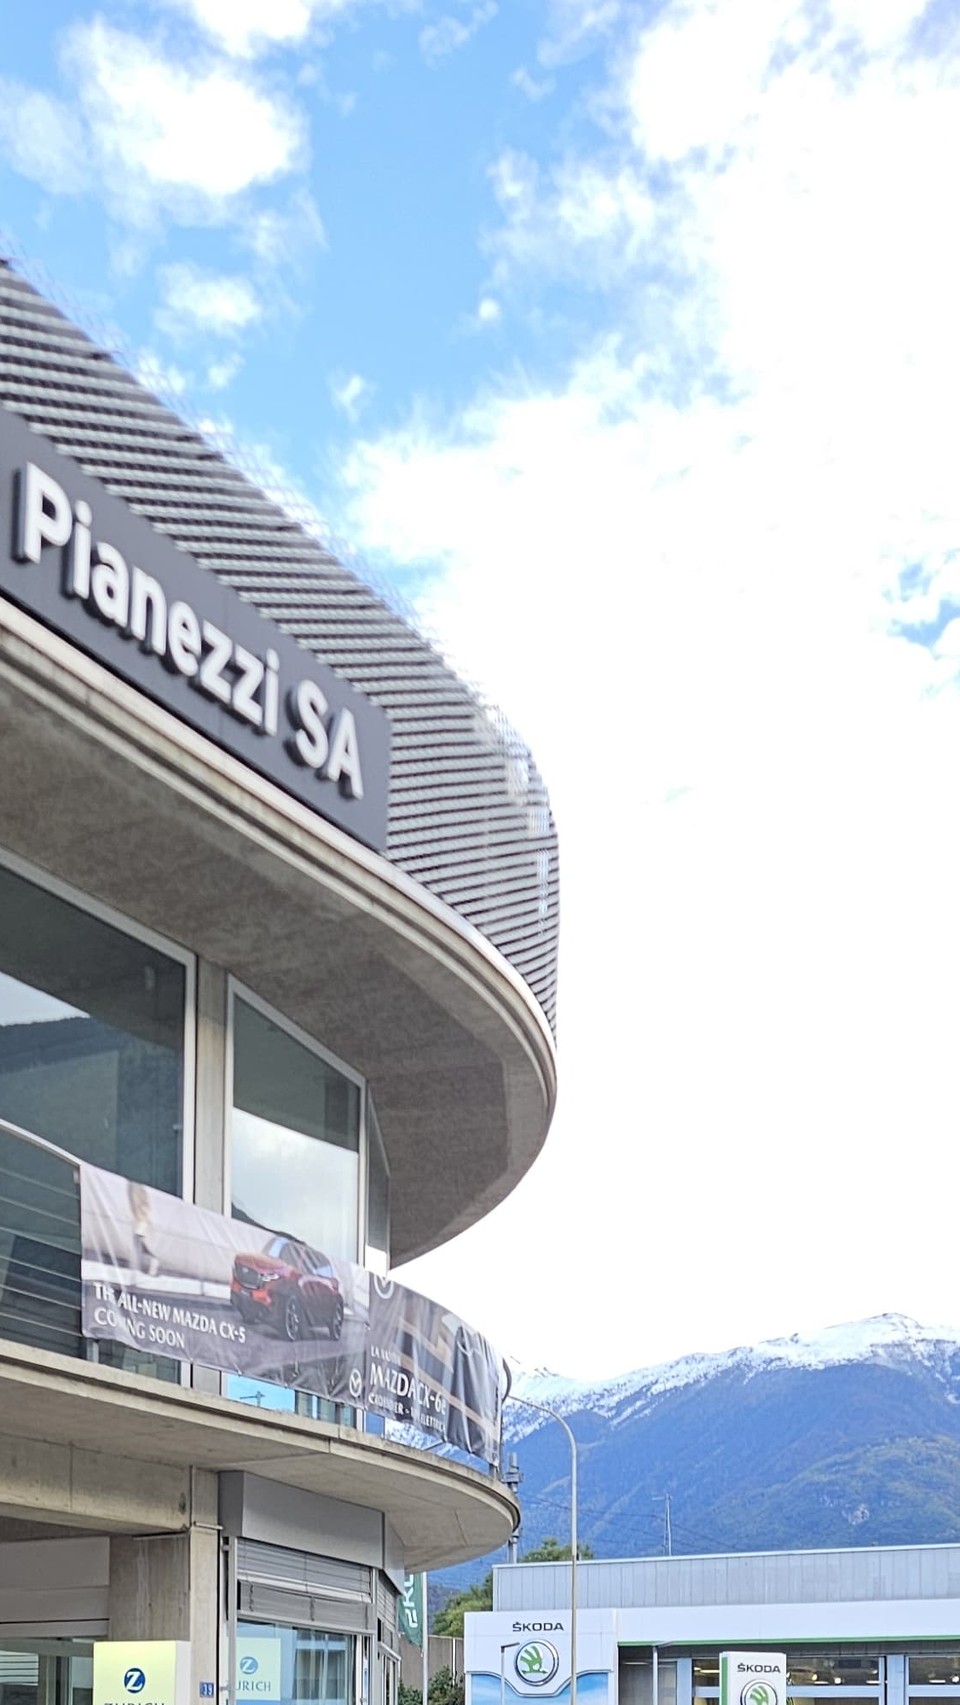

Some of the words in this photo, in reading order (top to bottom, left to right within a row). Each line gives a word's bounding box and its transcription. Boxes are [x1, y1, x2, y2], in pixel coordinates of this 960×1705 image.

[22, 462, 279, 737] Pianezzi
[294, 679, 364, 798] SA
[94, 1308, 146, 1339] CONG
[149, 1323, 185, 1349] SOON
[118, 1291, 171, 1321] ALL-NEW
[172, 1308, 218, 1336] MAZDA
[219, 1321, 246, 1344] CX-5
[370, 1362, 416, 1400] MAZDA
[512, 1621, 565, 1632] ŠKODA
[737, 1662, 781, 1673] ŠKODA
